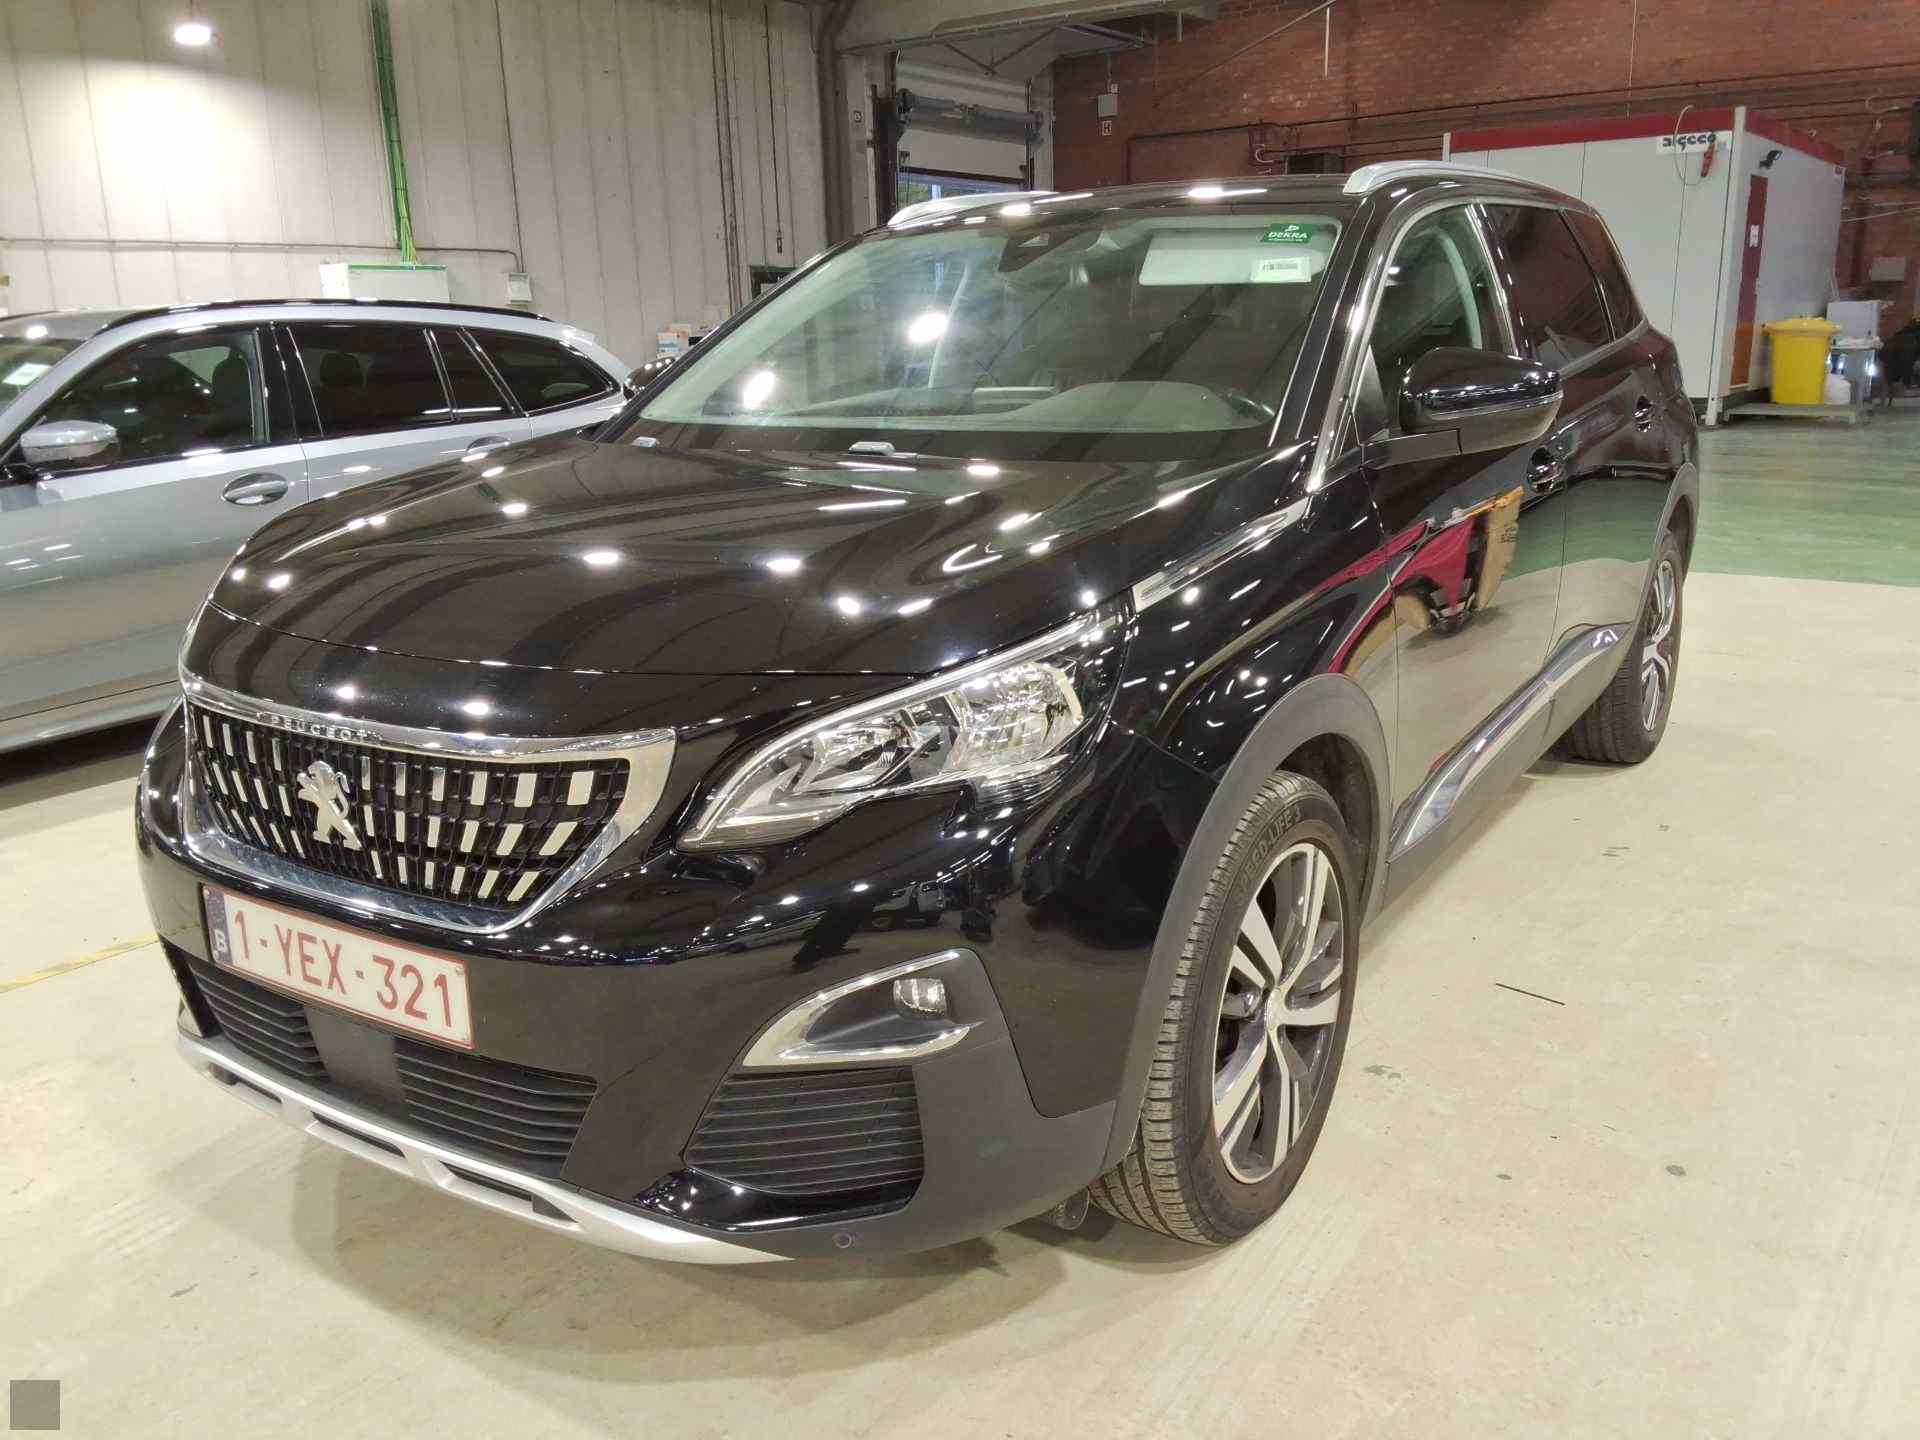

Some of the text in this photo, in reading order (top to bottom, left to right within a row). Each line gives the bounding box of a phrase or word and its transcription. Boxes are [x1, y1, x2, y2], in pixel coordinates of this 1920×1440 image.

[1268, 231, 1308, 239] DEKRA
[271, 715, 367, 741] PEUGEOT
[214, 929, 228, 953] B
[234, 910, 453, 1028] 1-YEX-321
